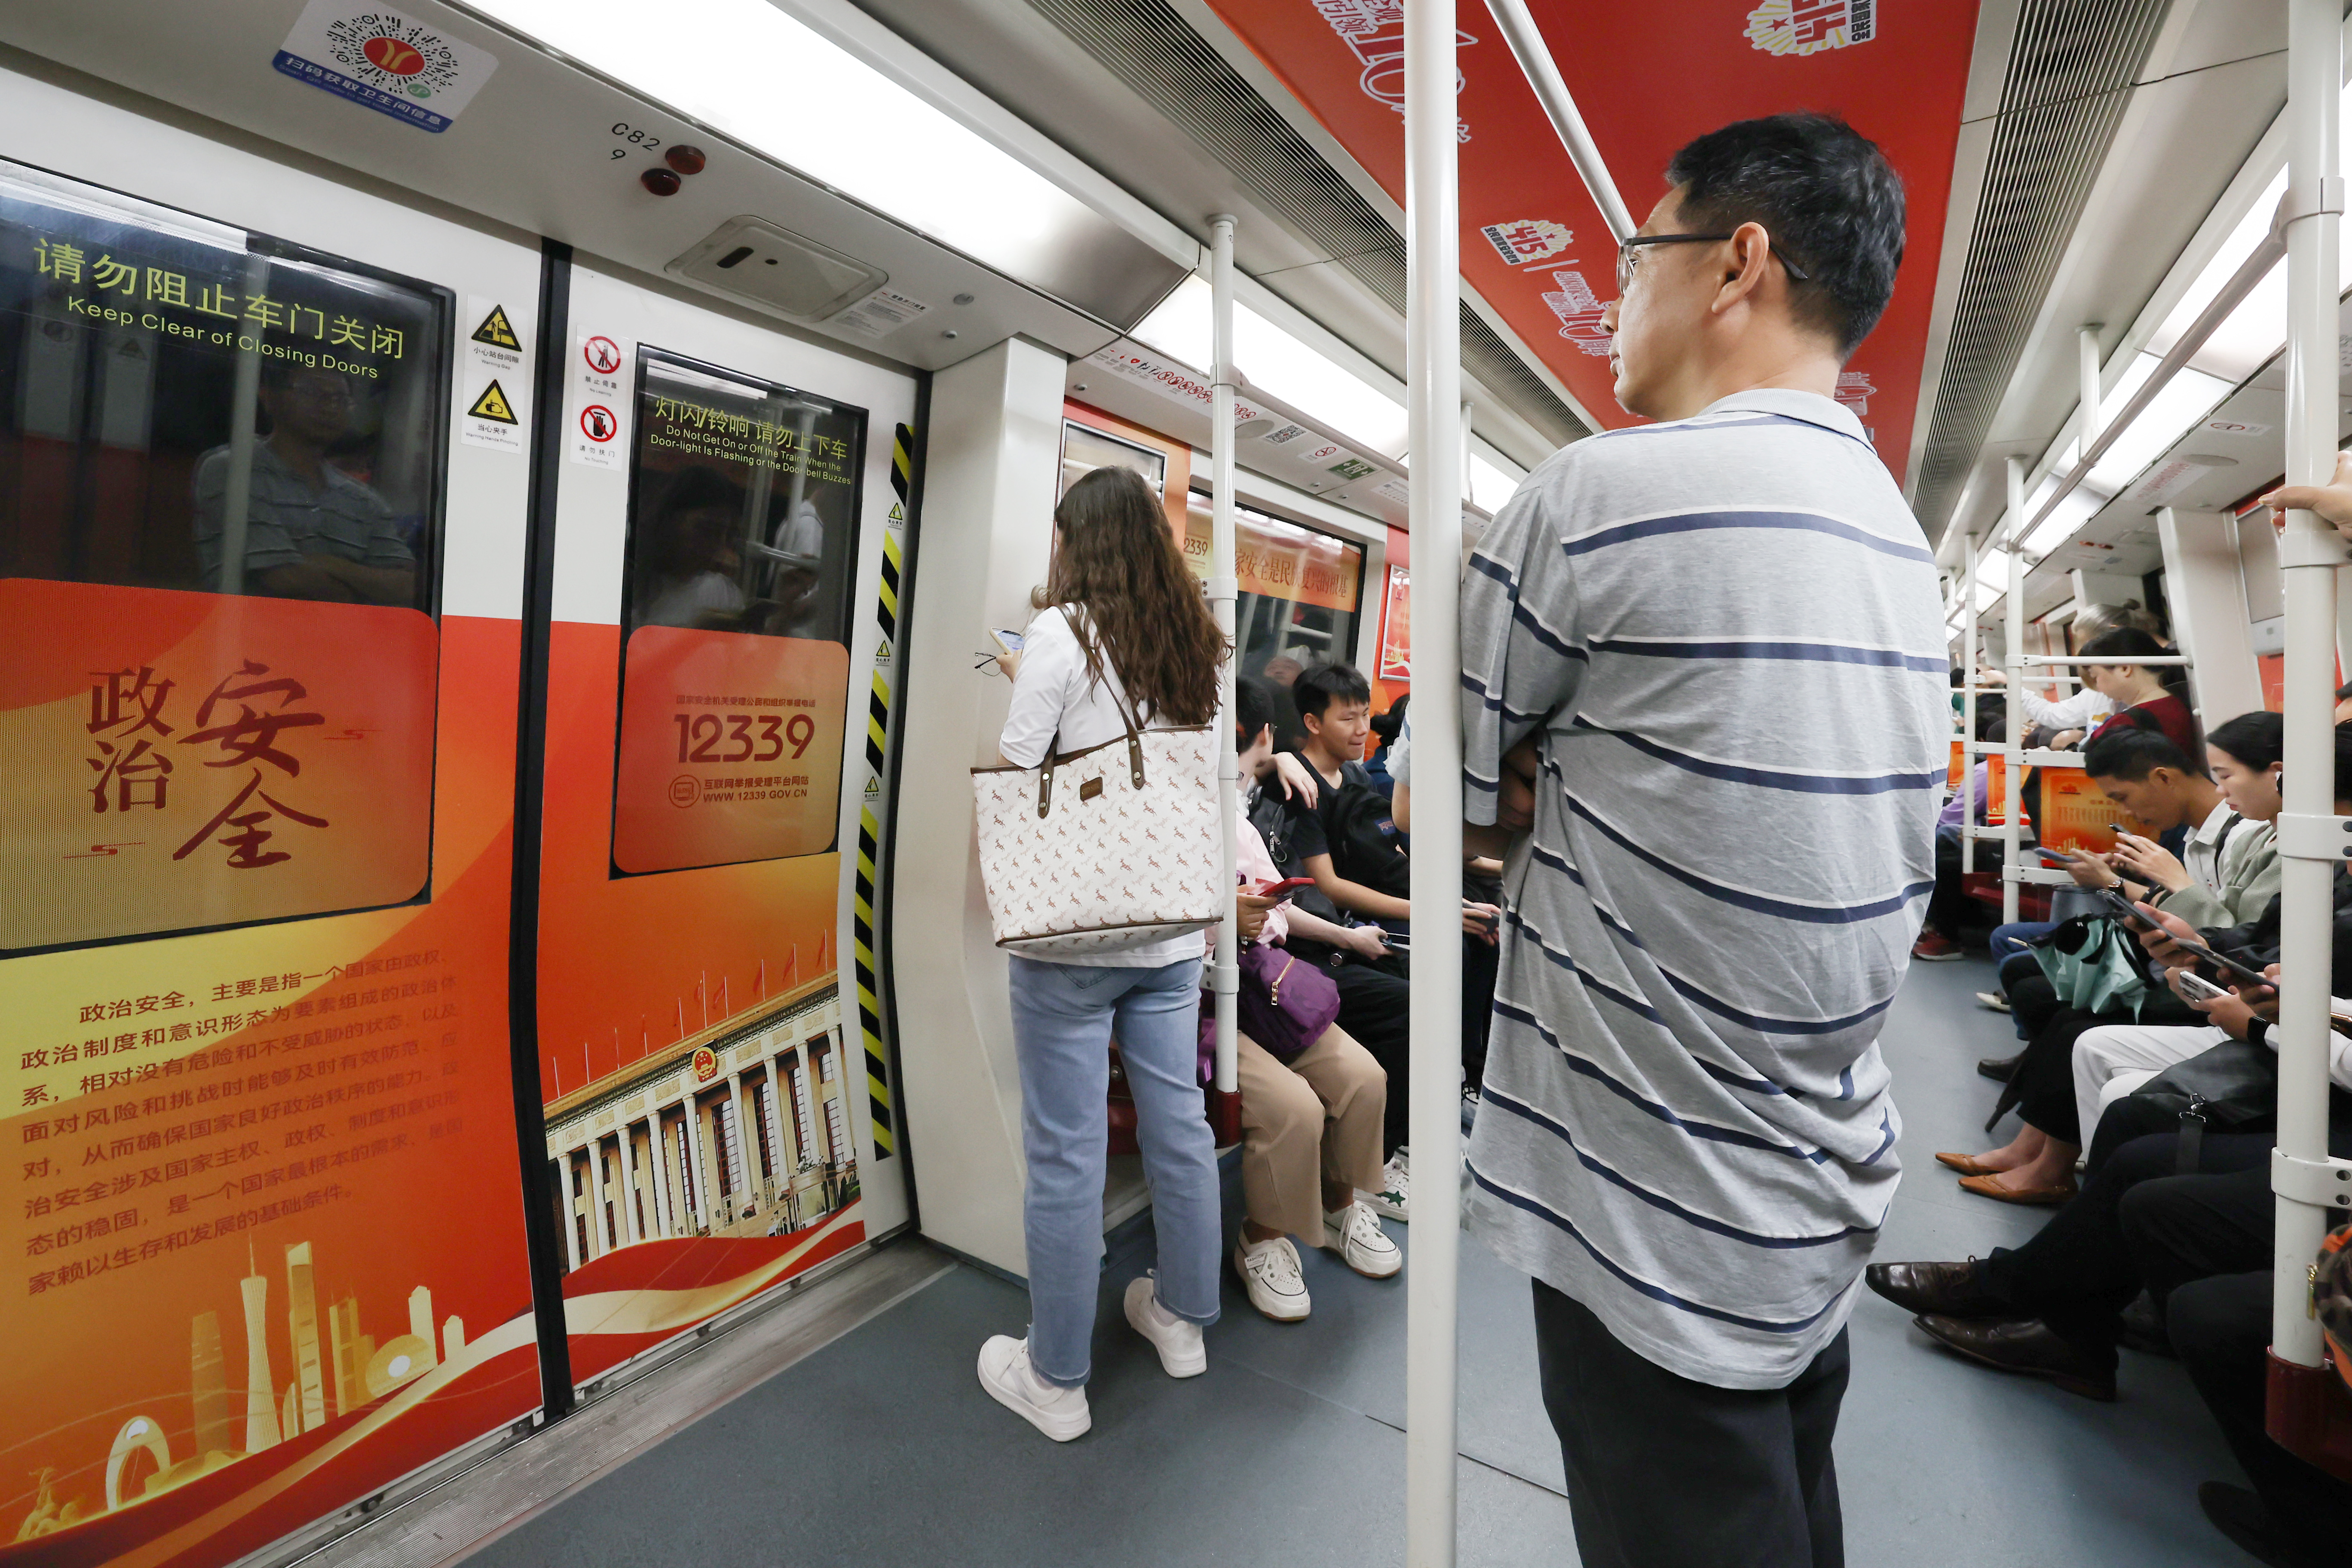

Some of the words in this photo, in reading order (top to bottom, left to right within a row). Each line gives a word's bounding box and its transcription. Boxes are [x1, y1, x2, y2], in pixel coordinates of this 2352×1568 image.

[1852, 0, 1870, 41] 全民国家
[279, 64, 302, 77] Scan
[306, 75, 322, 85] QR
[324, 83, 344, 93] code
[356, 95, 371, 105] get
[373, 101, 393, 113] toilet
[394, 109, 439, 132] information
[286, 57, 441, 124] 扫码获取卫生间信息
[611, 122, 660, 151] C82
[34, 239, 403, 359] 请勿阻止车门关闭
[68, 296, 134, 326] Keep
[142, 313, 205, 339] Clear
[211, 330, 232, 346] of
[238, 336, 315, 368] Closing
[323, 355, 378, 379] Doors
[481, 359, 500, 368] Warning
[478, 424, 508, 435] 当心夹手
[580, 445, 615, 457] 请勿扶门
[655, 396, 749, 438] 灯闪/铃响
[755, 420, 847, 459] 请勿上下车
[667, 425, 680, 436] Do
[683, 429, 701, 441] Not
[703, 433, 720, 446] Get
[723, 438, 736, 448] On
[750, 444, 764, 455] Off
[765, 447, 778, 458] the
[781, 450, 801, 462] Train
[805, 456, 826, 469] When
[829, 462, 841, 472] the
[651, 435, 701, 453] Door-light
[704, 445, 712, 456] Is
[715, 448, 754, 466] Flashing
[767, 459, 781, 471] the
[823, 472, 851, 485] Buzzes
[86, 665, 176, 813] 政治
[674, 714, 815, 763] 12339
[172, 659, 329, 869] 安全
[704, 775, 809, 790] 互联网举报受理平台网站
[21, 976, 456, 1070] 政治制度和意识形态为要素组成的政治体
